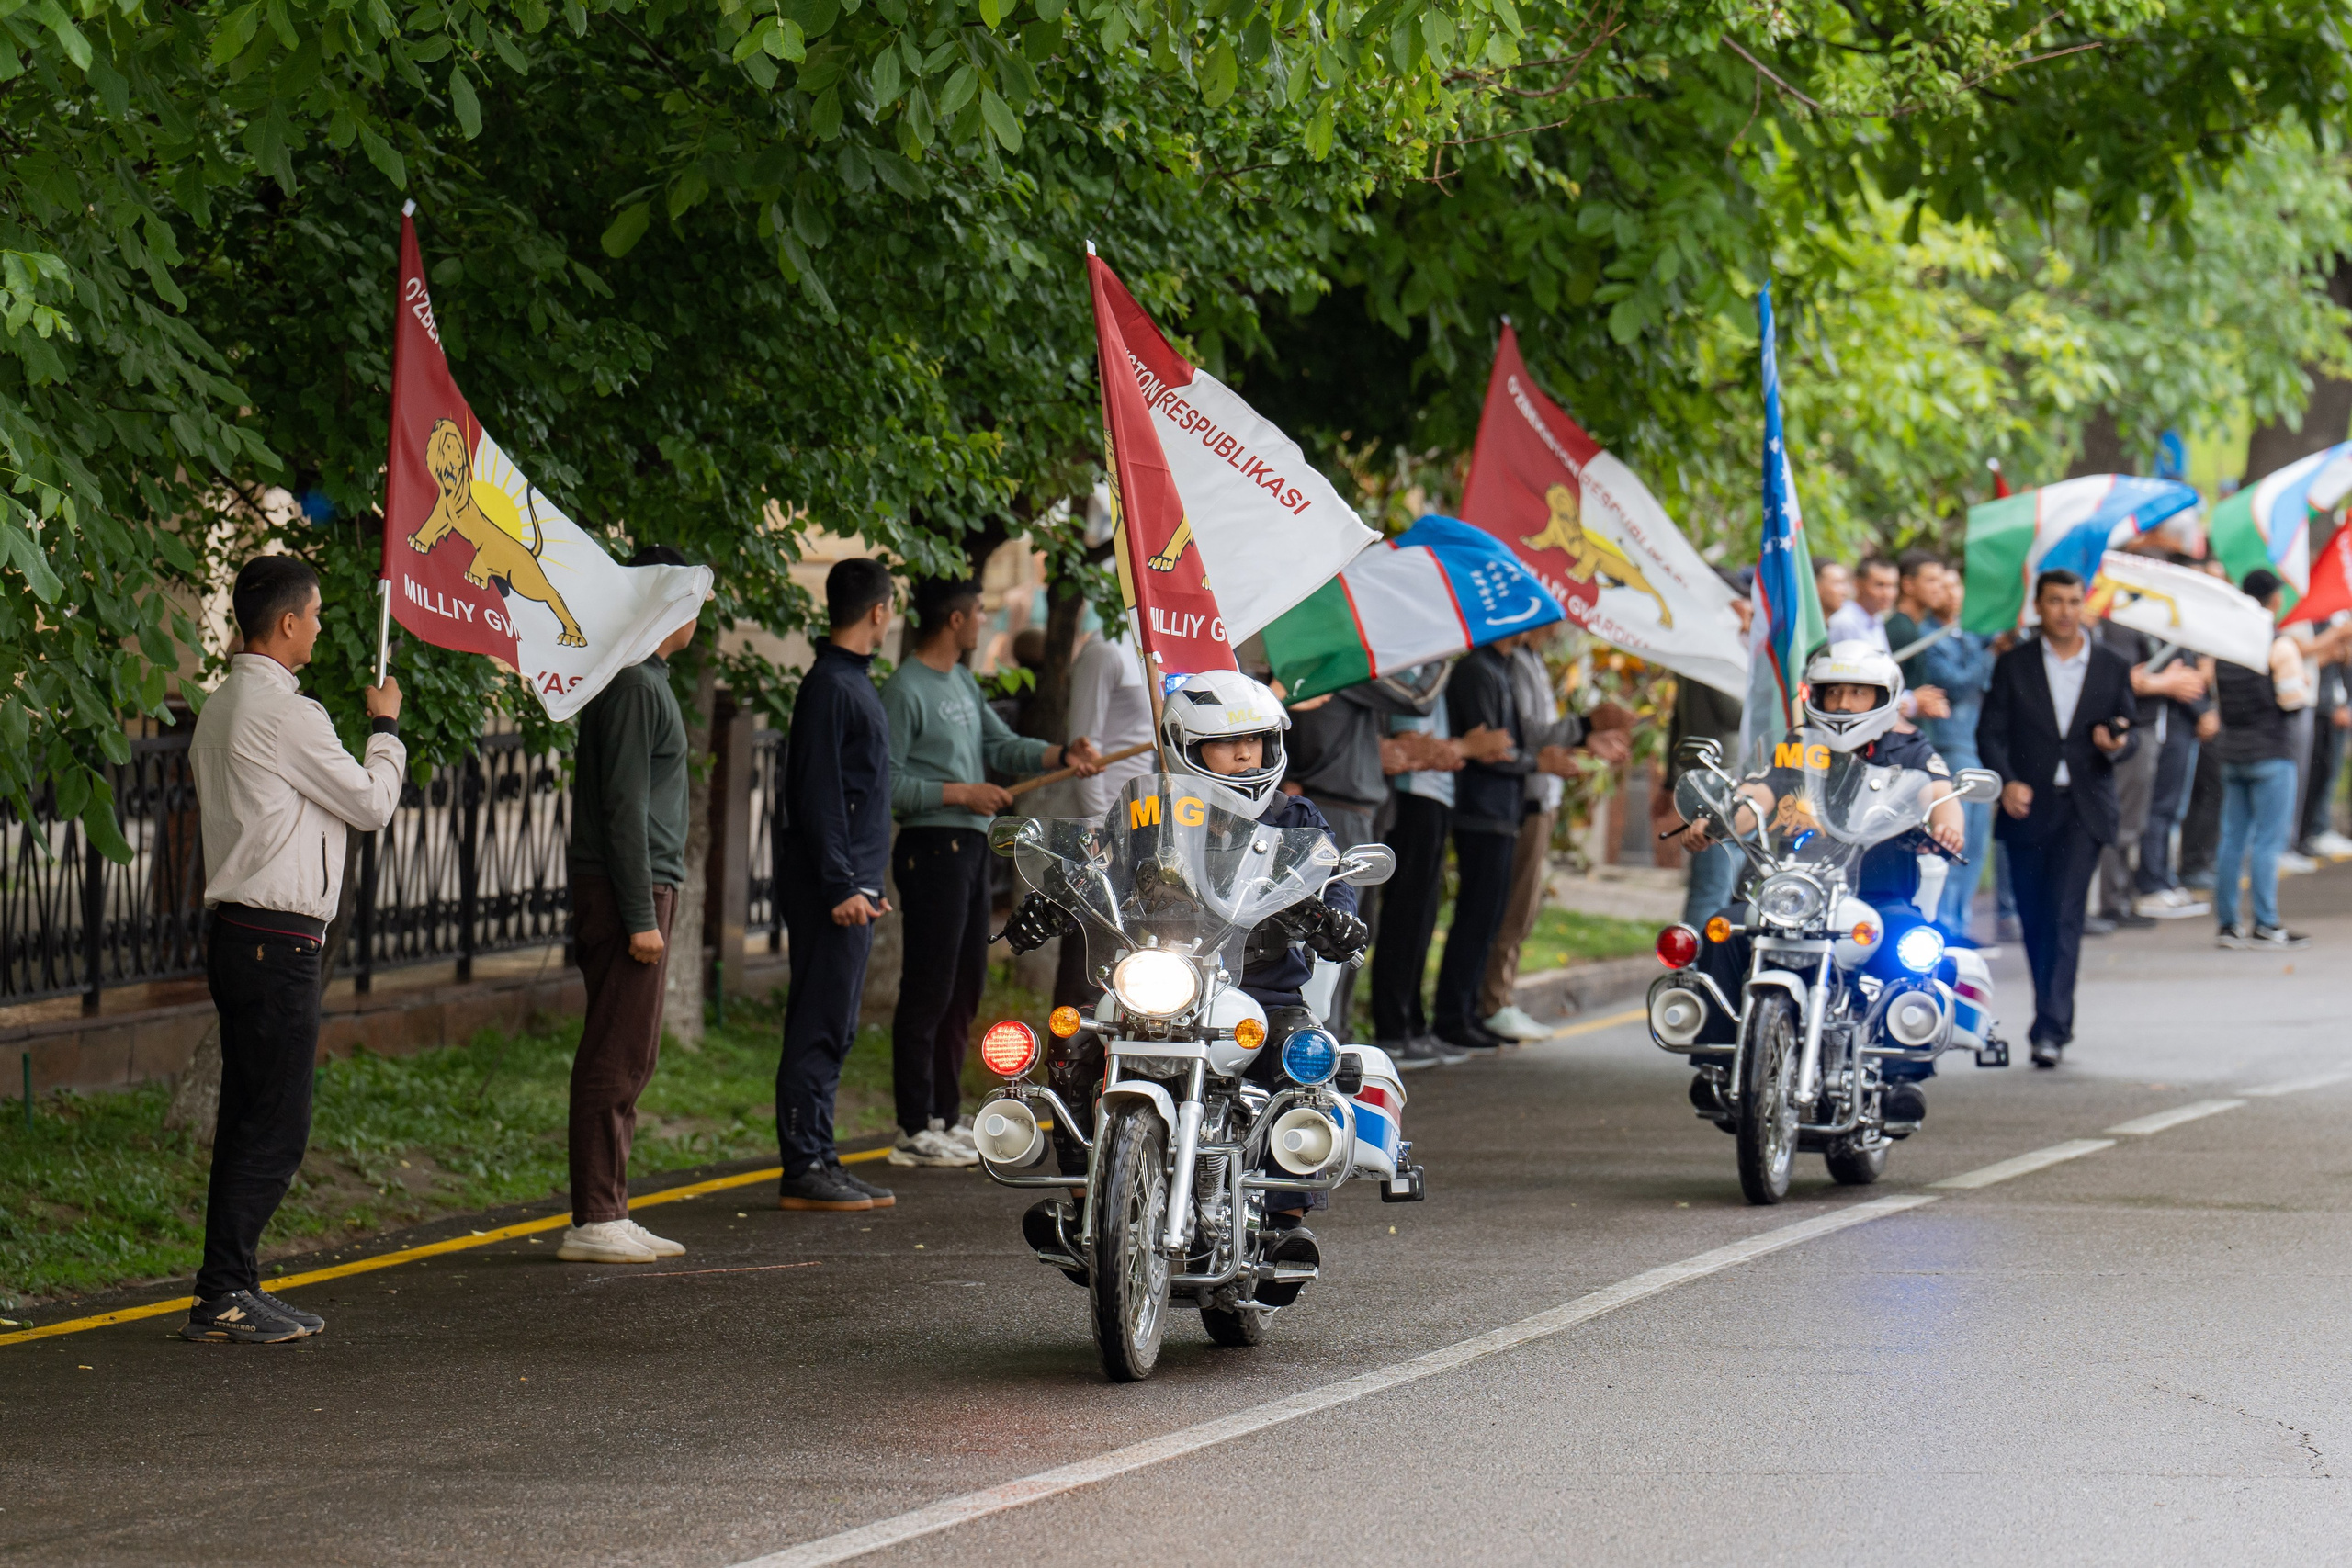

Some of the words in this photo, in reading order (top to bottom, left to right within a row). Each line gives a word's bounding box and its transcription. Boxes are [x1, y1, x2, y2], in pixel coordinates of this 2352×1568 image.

[1156, 391, 1311, 516] RESPUBLIKASI
[404, 573, 475, 623] MILLIY
[1774, 742, 1832, 770] MG
[1129, 795, 1205, 830] MG
